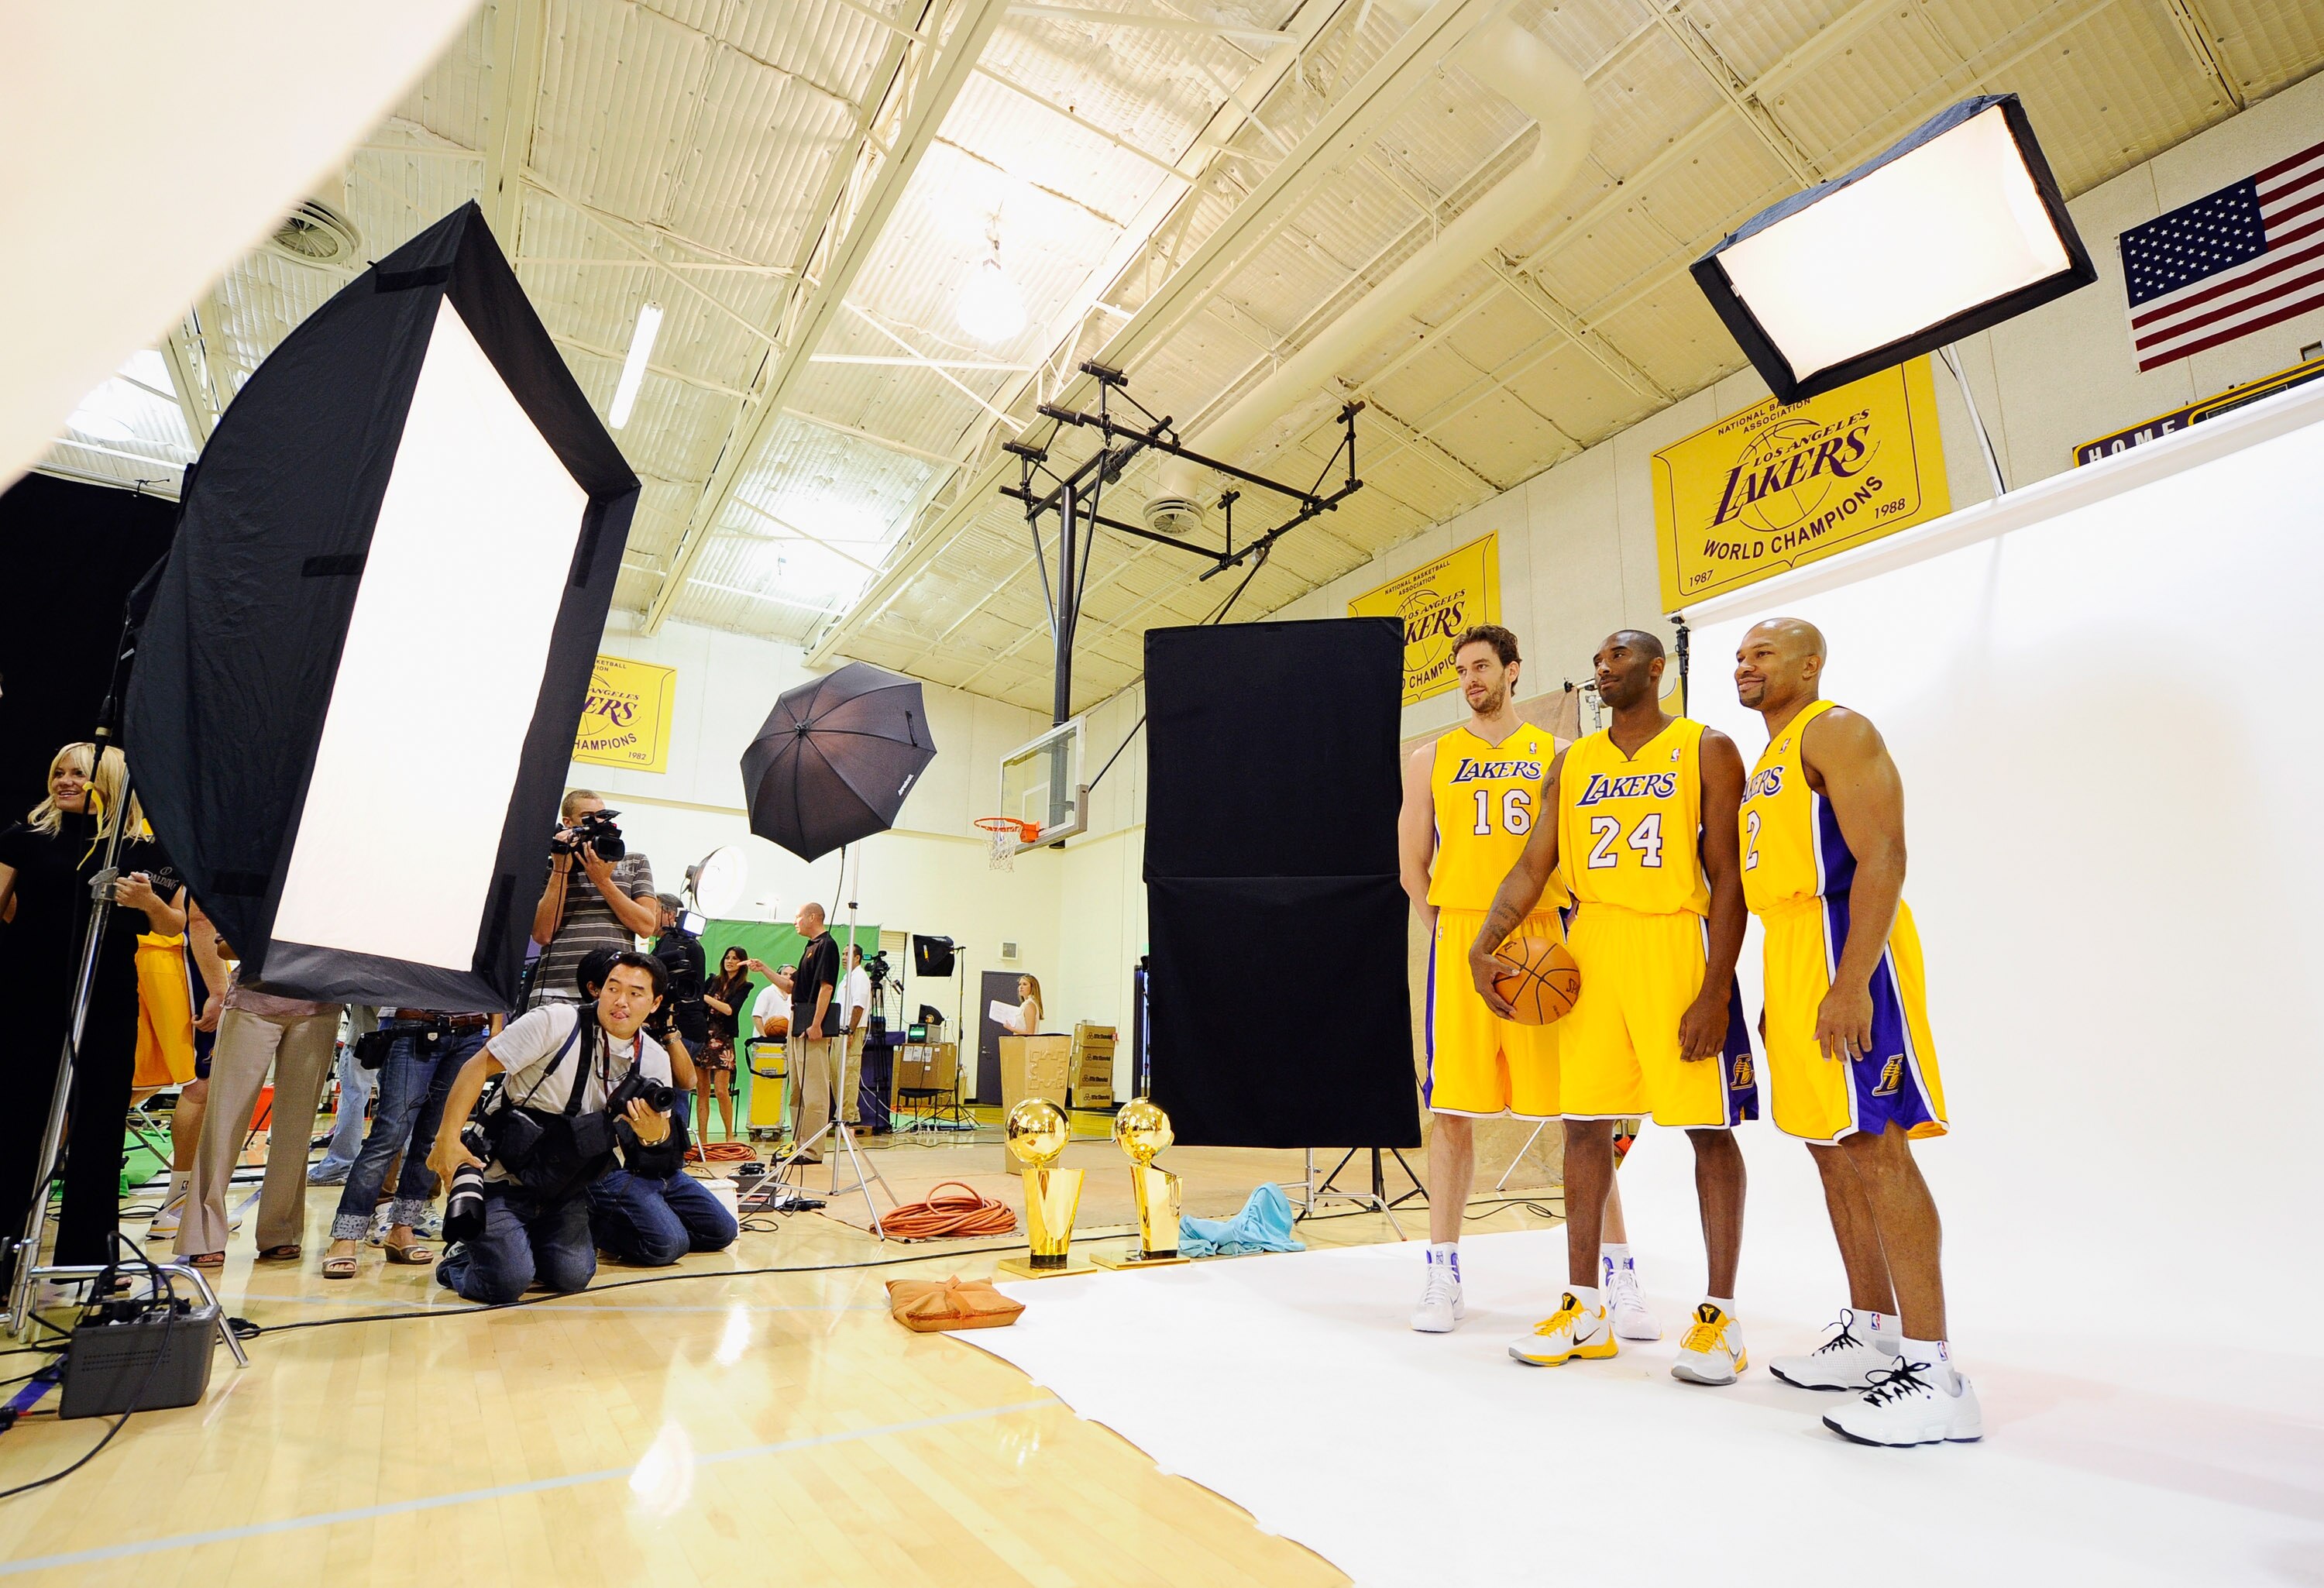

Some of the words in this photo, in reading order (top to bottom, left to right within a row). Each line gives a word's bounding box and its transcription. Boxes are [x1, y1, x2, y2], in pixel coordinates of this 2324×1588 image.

[1717, 408, 1766, 436] NATIONAL
[1743, 397, 1811, 434] ASSOCIATION
[1753, 447, 1783, 468] LOS
[1786, 407, 1871, 453] ANGELES
[2088, 419, 2175, 462] HOME
[1707, 424, 1880, 530] LAKERS
[1703, 538, 1765, 561] WORLD
[1771, 475, 1884, 553] CHAMPIONS
[1874, 497, 1906, 520] 1988
[1384, 579, 1411, 596] NATIONAL
[1413, 560, 1451, 583] BASKETBALL
[1397, 574, 1436, 596] ASSOCIATION
[1689, 569, 1714, 587] 1987
[1420, 588, 1466, 615] ANGELES
[1404, 600, 1469, 648] KERS
[596, 659, 627, 669] KETBALL
[1409, 653, 1456, 689] CHAMPIO
[583, 696, 641, 727] ERS
[589, 688, 640, 700] ANGELES
[574, 733, 637, 751] HAMPIONS
[628, 751, 646, 761] 1982
[1449, 758, 1542, 785] LAKERS
[1575, 771, 1677, 808] LAKERS
[1741, 765, 1785, 804] AKERS
[1473, 789, 1532, 836] 16
[1587, 813, 1663, 870] 24
[1745, 809, 1762, 873] 2
[143, 869, 180, 890] PALDING
